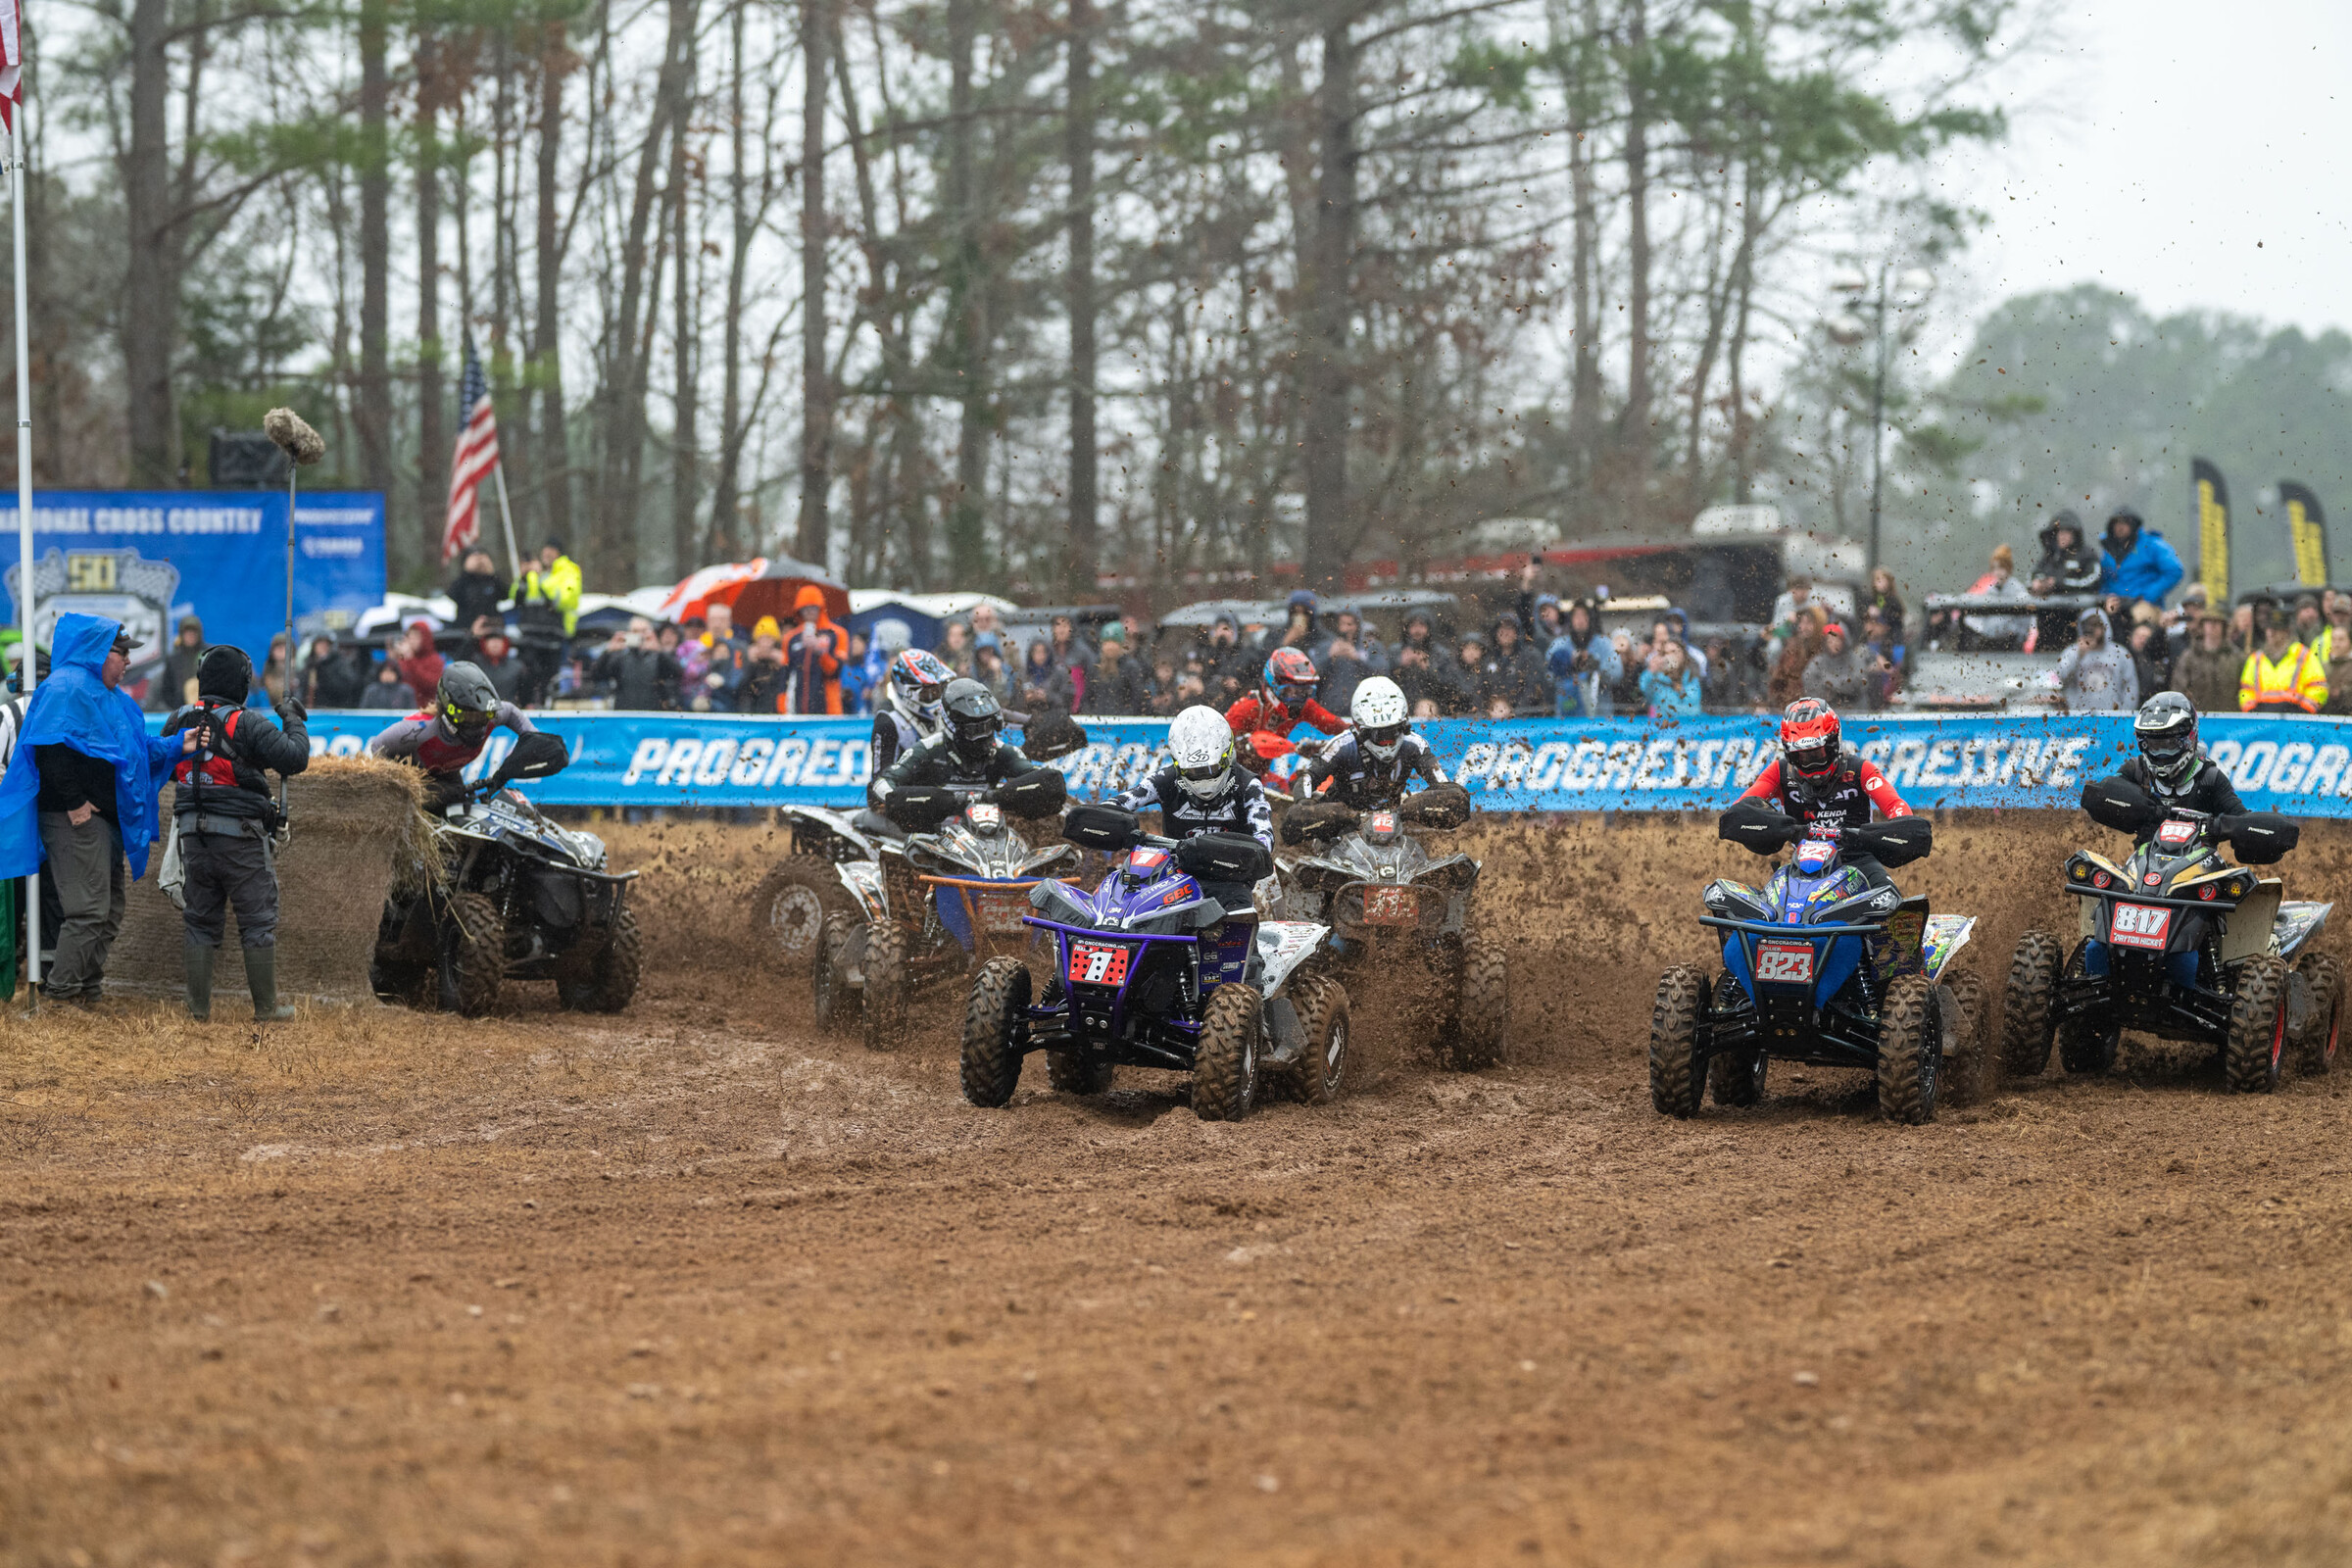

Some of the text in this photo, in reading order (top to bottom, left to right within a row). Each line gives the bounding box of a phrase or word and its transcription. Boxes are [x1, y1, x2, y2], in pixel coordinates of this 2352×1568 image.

[95, 508, 165, 534] CROSS
[169, 508, 263, 534] COUNTRY
[1373, 713, 1393, 724] FLY
[1187, 749, 1209, 762] 6D
[1817, 809, 1847, 818] KENDA
[1373, 817, 1394, 827] 412
[2161, 825, 2194, 837] 817
[1136, 852, 1156, 864] 1
[1163, 884, 1194, 905] GBC
[2114, 905, 2170, 935] 817
[1084, 951, 1113, 982] 1
[1757, 952, 1812, 981] 823
